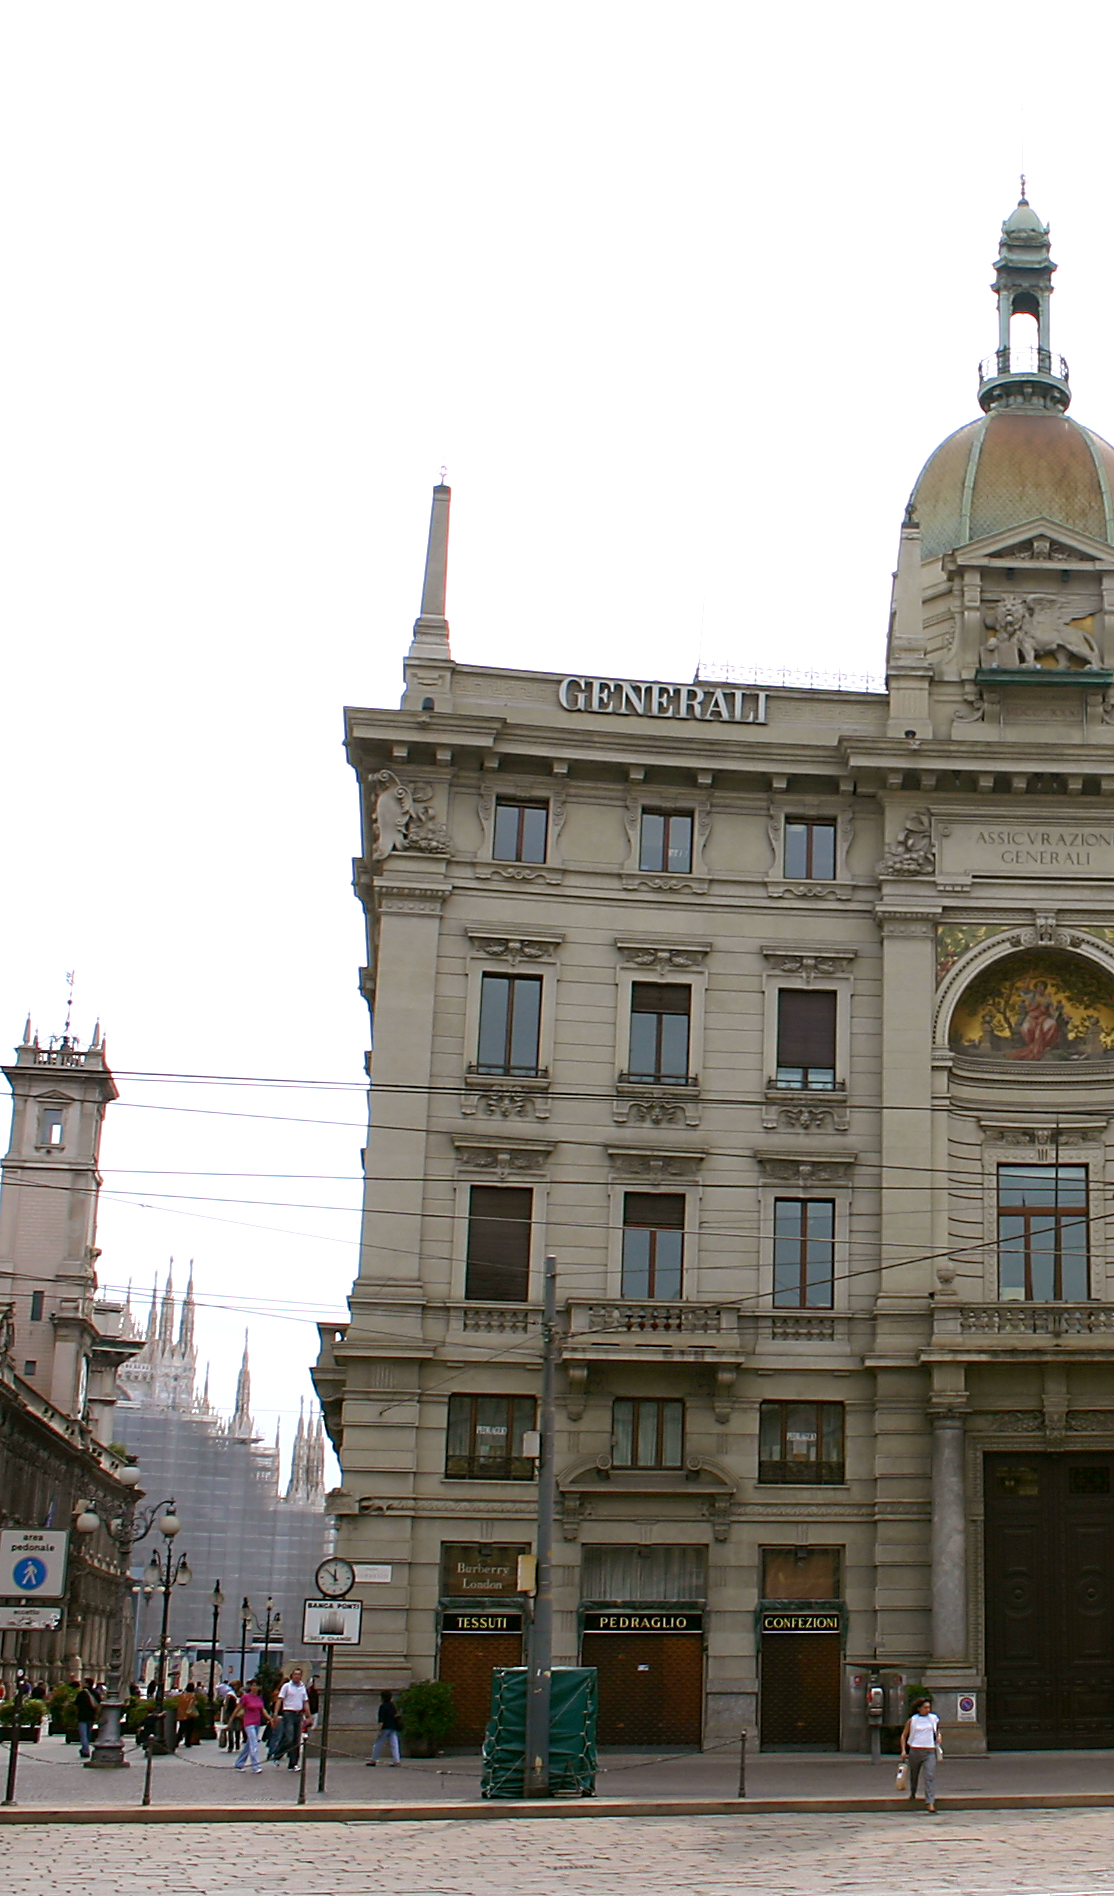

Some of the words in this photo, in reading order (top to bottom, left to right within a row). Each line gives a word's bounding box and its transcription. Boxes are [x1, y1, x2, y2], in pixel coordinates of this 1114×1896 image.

[558, 676, 769, 724] GENERALI
[1001, 850, 1090, 865] GENERALI
[11, 1543, 55, 1552] pedonale
[457, 1562, 509, 1576] Burberry
[463, 1578, 502, 1589] London
[457, 1617, 507, 1629] TESSUTI
[599, 1617, 688, 1628] PEDRAGLIO
[764, 1617, 838, 1629] CONFEZIONI
